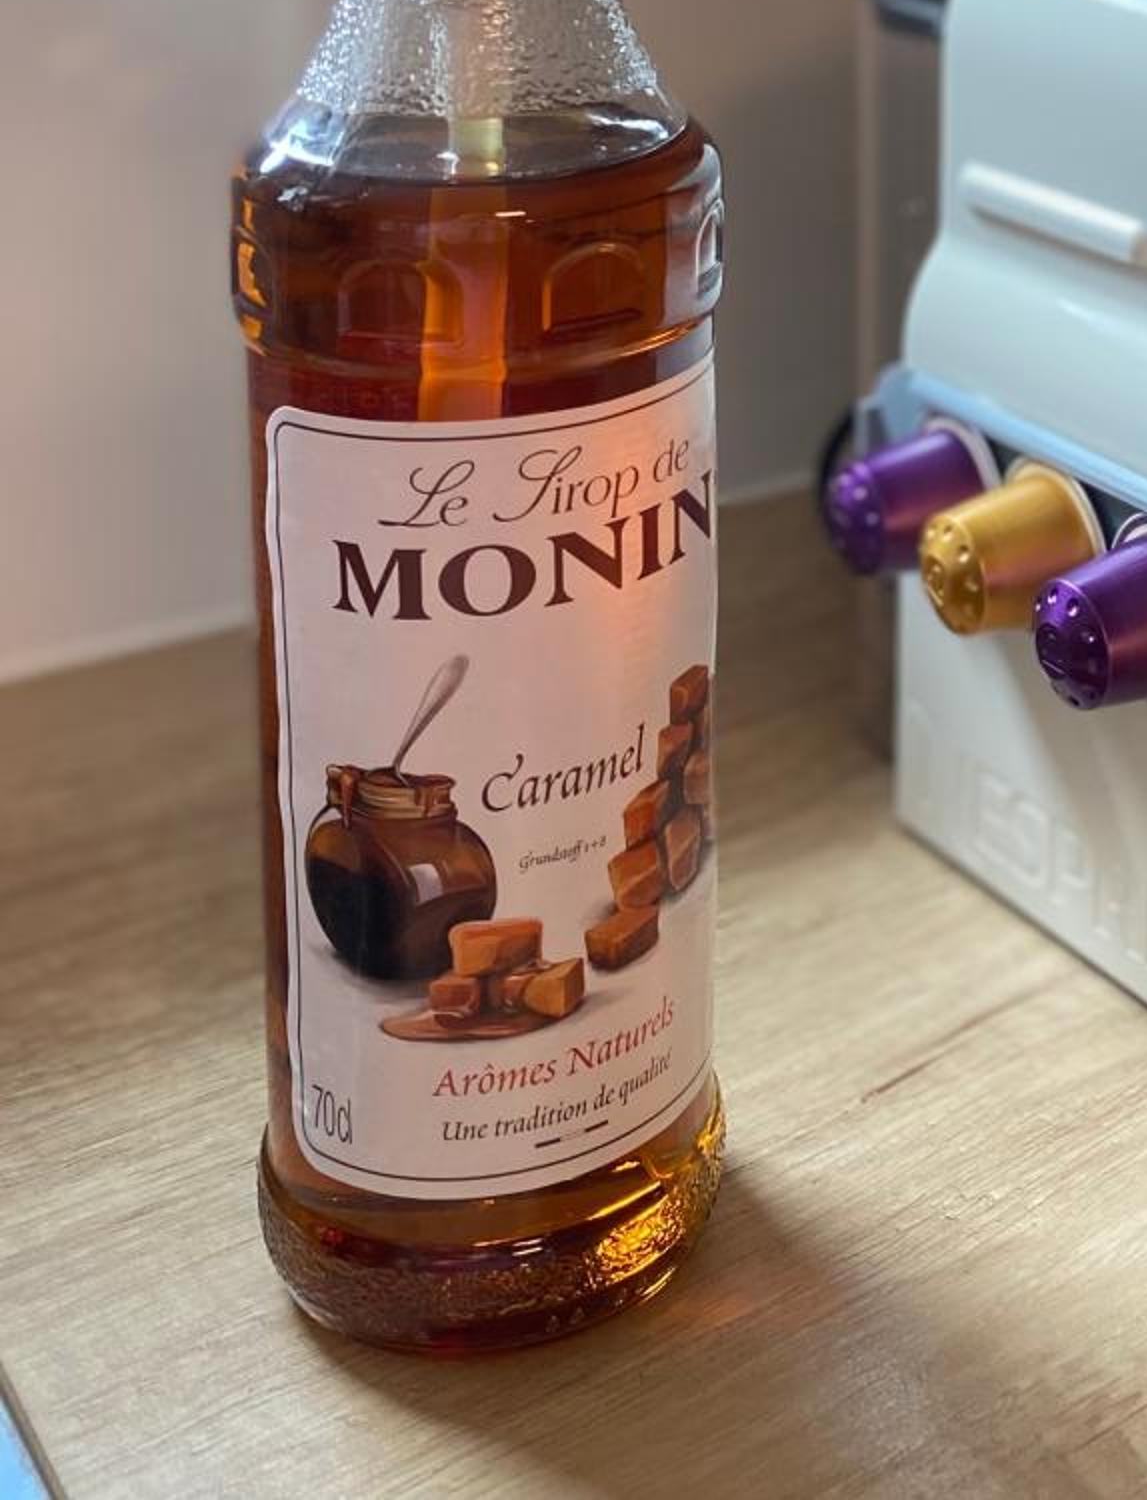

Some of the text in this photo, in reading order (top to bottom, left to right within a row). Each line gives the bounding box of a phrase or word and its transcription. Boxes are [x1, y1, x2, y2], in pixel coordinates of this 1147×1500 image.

[377, 439, 689, 528] Le Sirop de
[331, 468, 711, 621] MONIN
[481, 721, 645, 812] Caramel
[432, 995, 673, 1097] Arômes Naturels
[312, 1084, 353, 1145] 70cl
[442, 1120, 488, 1142] Une
[494, 1100, 588, 1137] tradition
[593, 1084, 615, 1111] de
[619, 1047, 672, 1106] qualité
